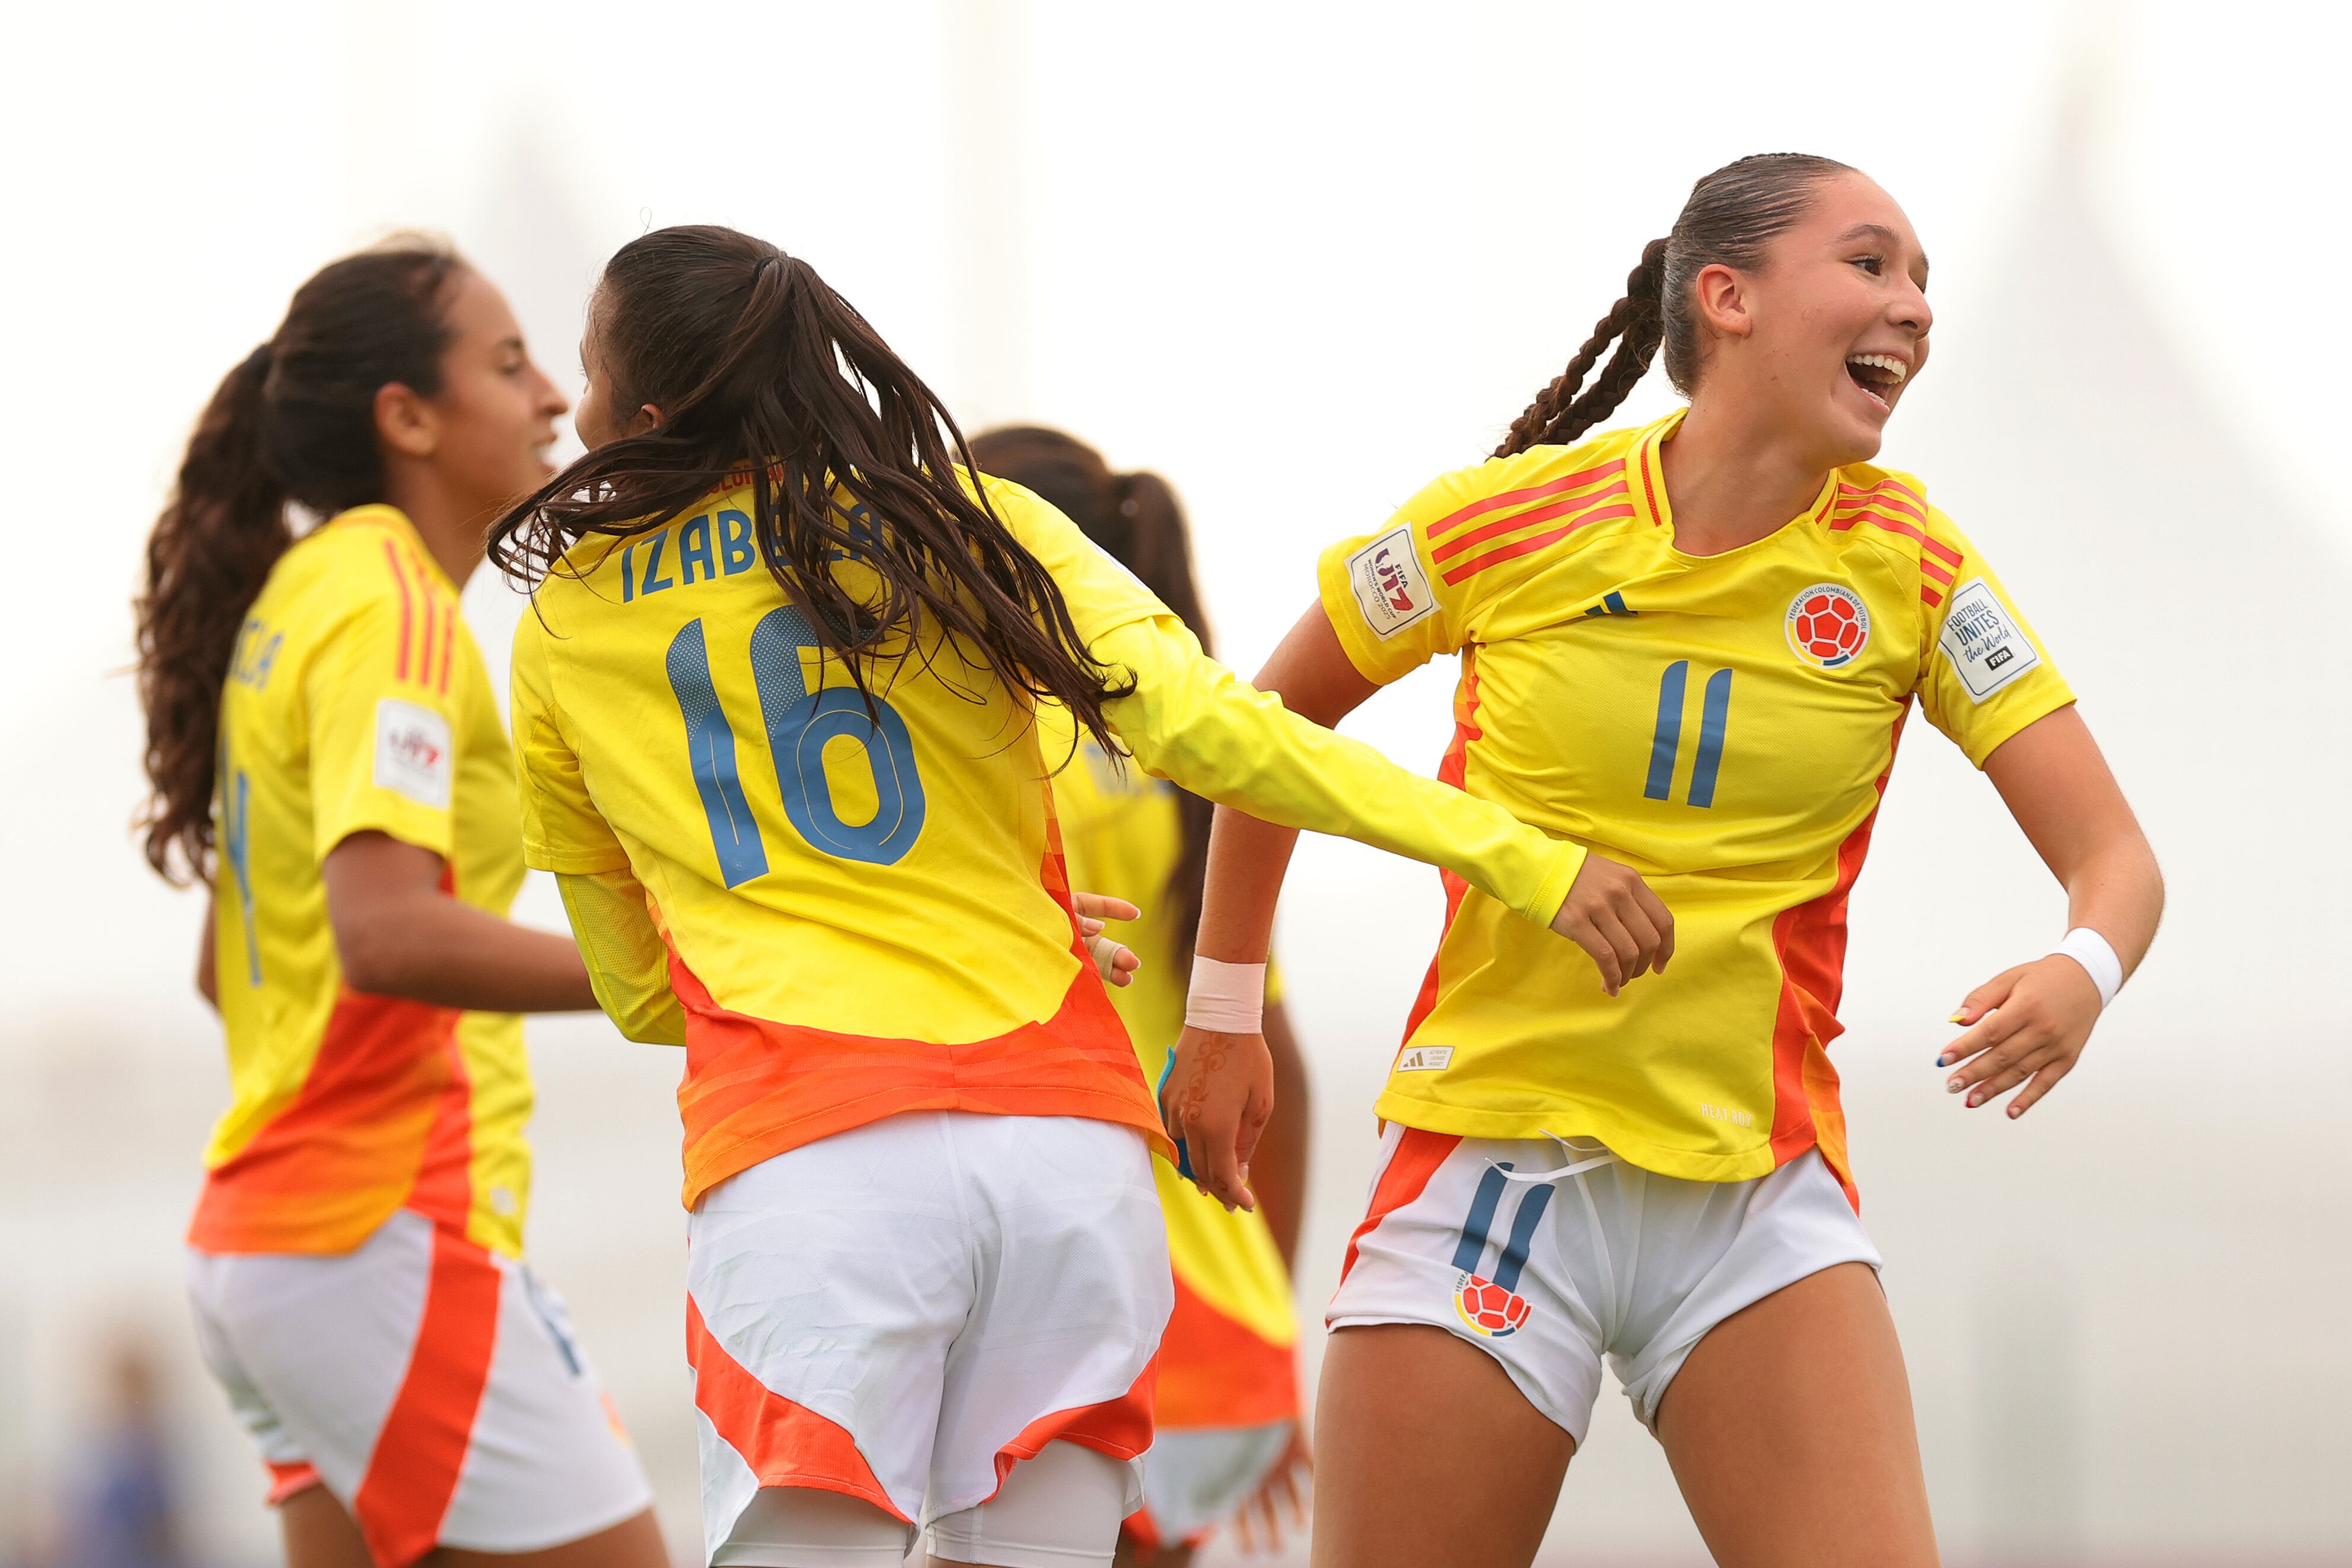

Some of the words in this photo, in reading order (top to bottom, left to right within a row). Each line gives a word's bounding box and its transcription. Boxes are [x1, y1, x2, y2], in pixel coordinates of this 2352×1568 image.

[1363, 563, 1380, 602] MOROCCO
[1378, 603, 1391, 620] 2025
[1395, 563, 1408, 588] FIFA
[1376, 587, 1389, 607] WORLD
[1388, 608, 1397, 619] CUP
[1815, 587, 1853, 601] COLOMBIANA
[1946, 598, 1988, 632] FOOTBALL
[1955, 610, 1999, 646] UNITES
[1963, 646, 1983, 663] the
[1981, 624, 2012, 651] World
[1989, 649, 2012, 667] FIFA
[666, 603, 926, 890] 16
[1644, 659, 1733, 808] 11
[1451, 1162, 1556, 1293] 11
